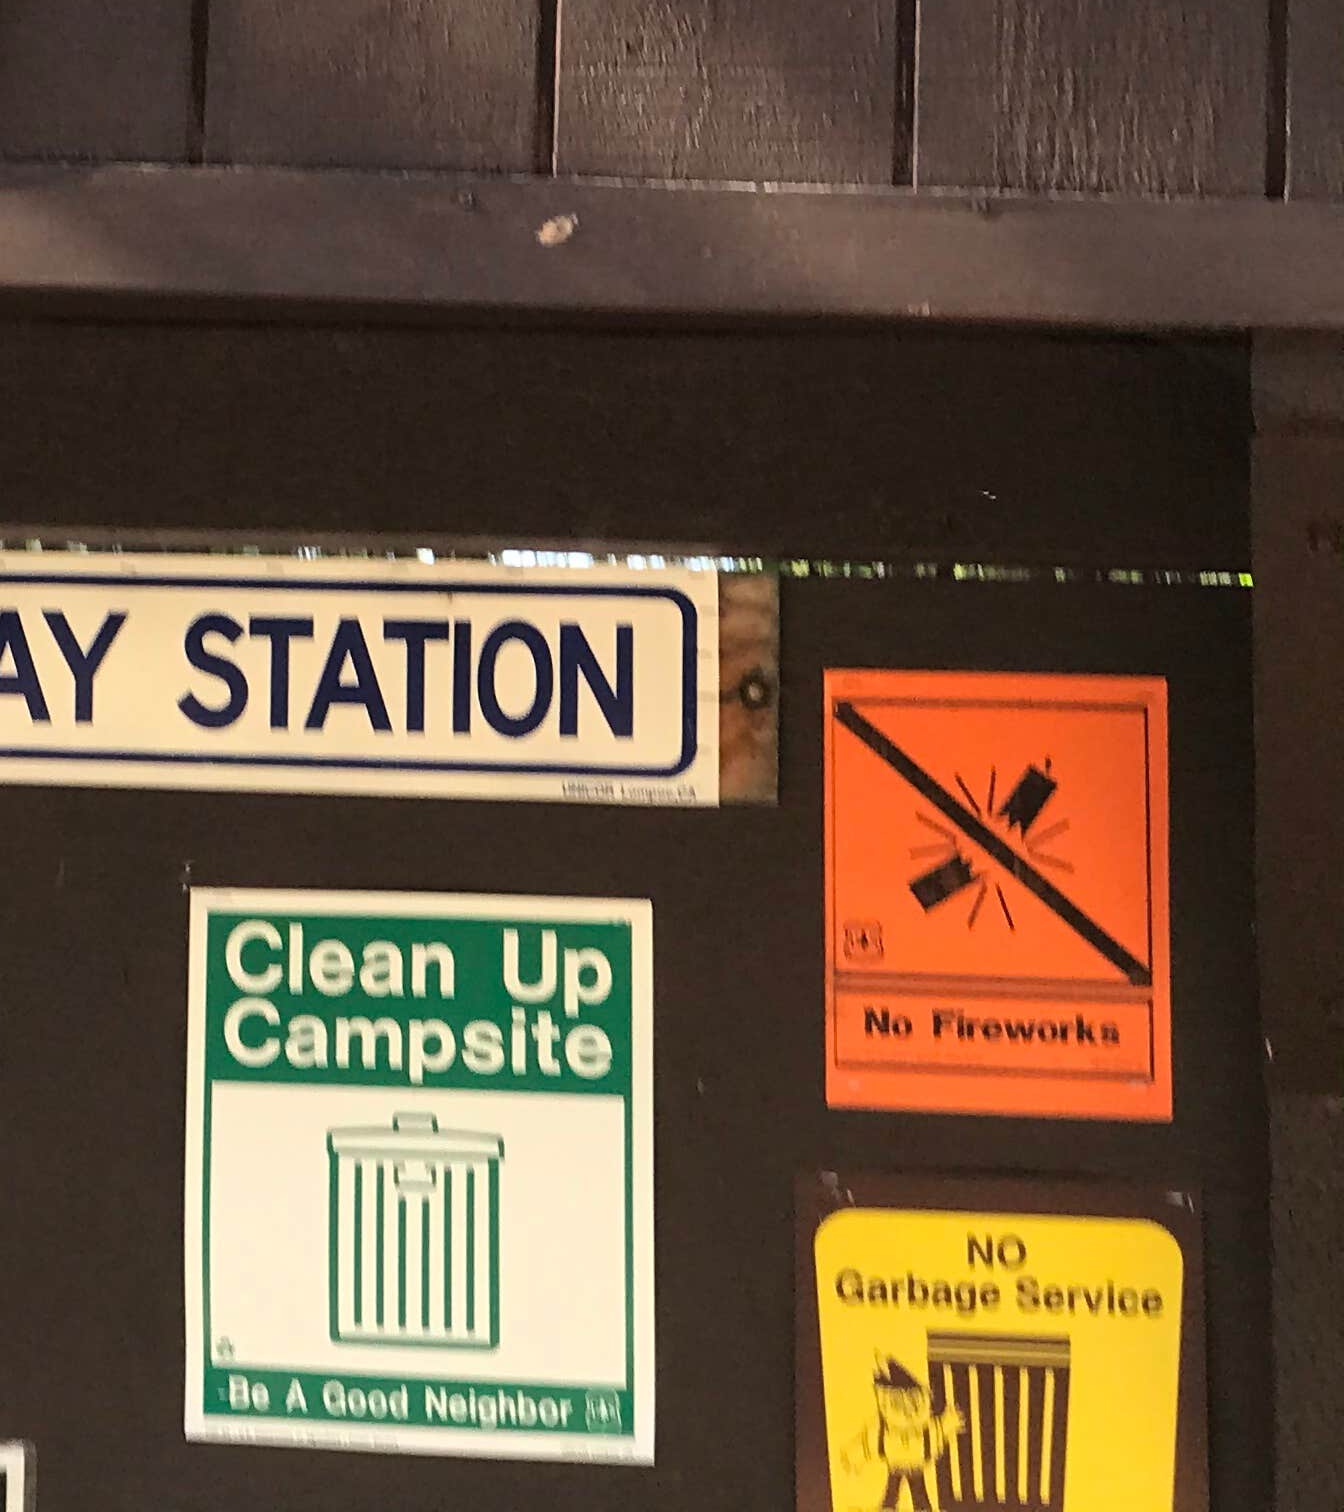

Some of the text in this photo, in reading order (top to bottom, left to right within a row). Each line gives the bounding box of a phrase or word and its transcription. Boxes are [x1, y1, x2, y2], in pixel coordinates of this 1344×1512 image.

[178, 615, 639, 738] STATION
[224, 919, 613, 1018] Clean Up
[223, 996, 613, 1087] Campsite
[863, 1004, 1120, 1048] No Fireworks
[966, 1231, 1028, 1272] NO
[835, 1266, 1164, 1321] Garbage Service
[227, 1373, 573, 1432] Be A Good Neighbor
